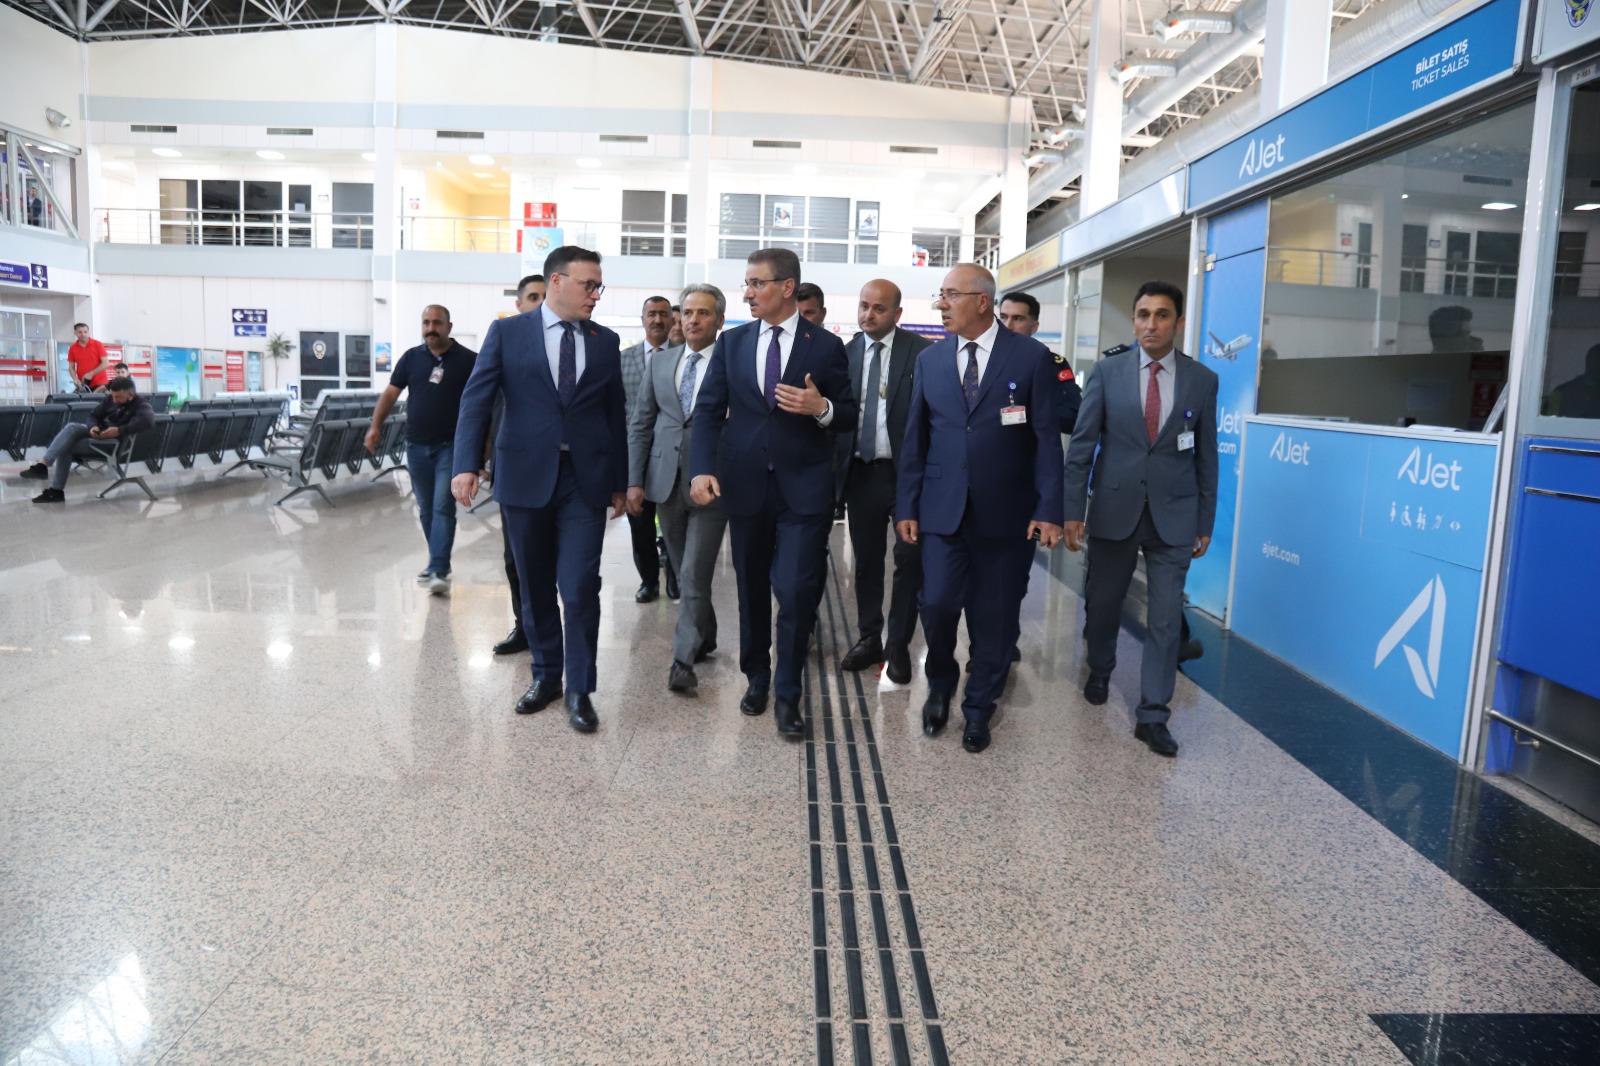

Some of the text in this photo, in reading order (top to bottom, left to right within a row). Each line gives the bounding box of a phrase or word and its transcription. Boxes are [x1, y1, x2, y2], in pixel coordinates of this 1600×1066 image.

[1411, 54, 1470, 91] TICKET SALES
[1415, 38, 1469, 75] BİLET SATIŞ
[1238, 133, 1286, 180] AJet
[1216, 406, 1240, 435] Jet
[1217, 441, 1237, 456] .com
[1269, 431, 1311, 466] AJet
[1397, 445, 1463, 492] AJet
[1262, 540, 1300, 567] ajet.com
